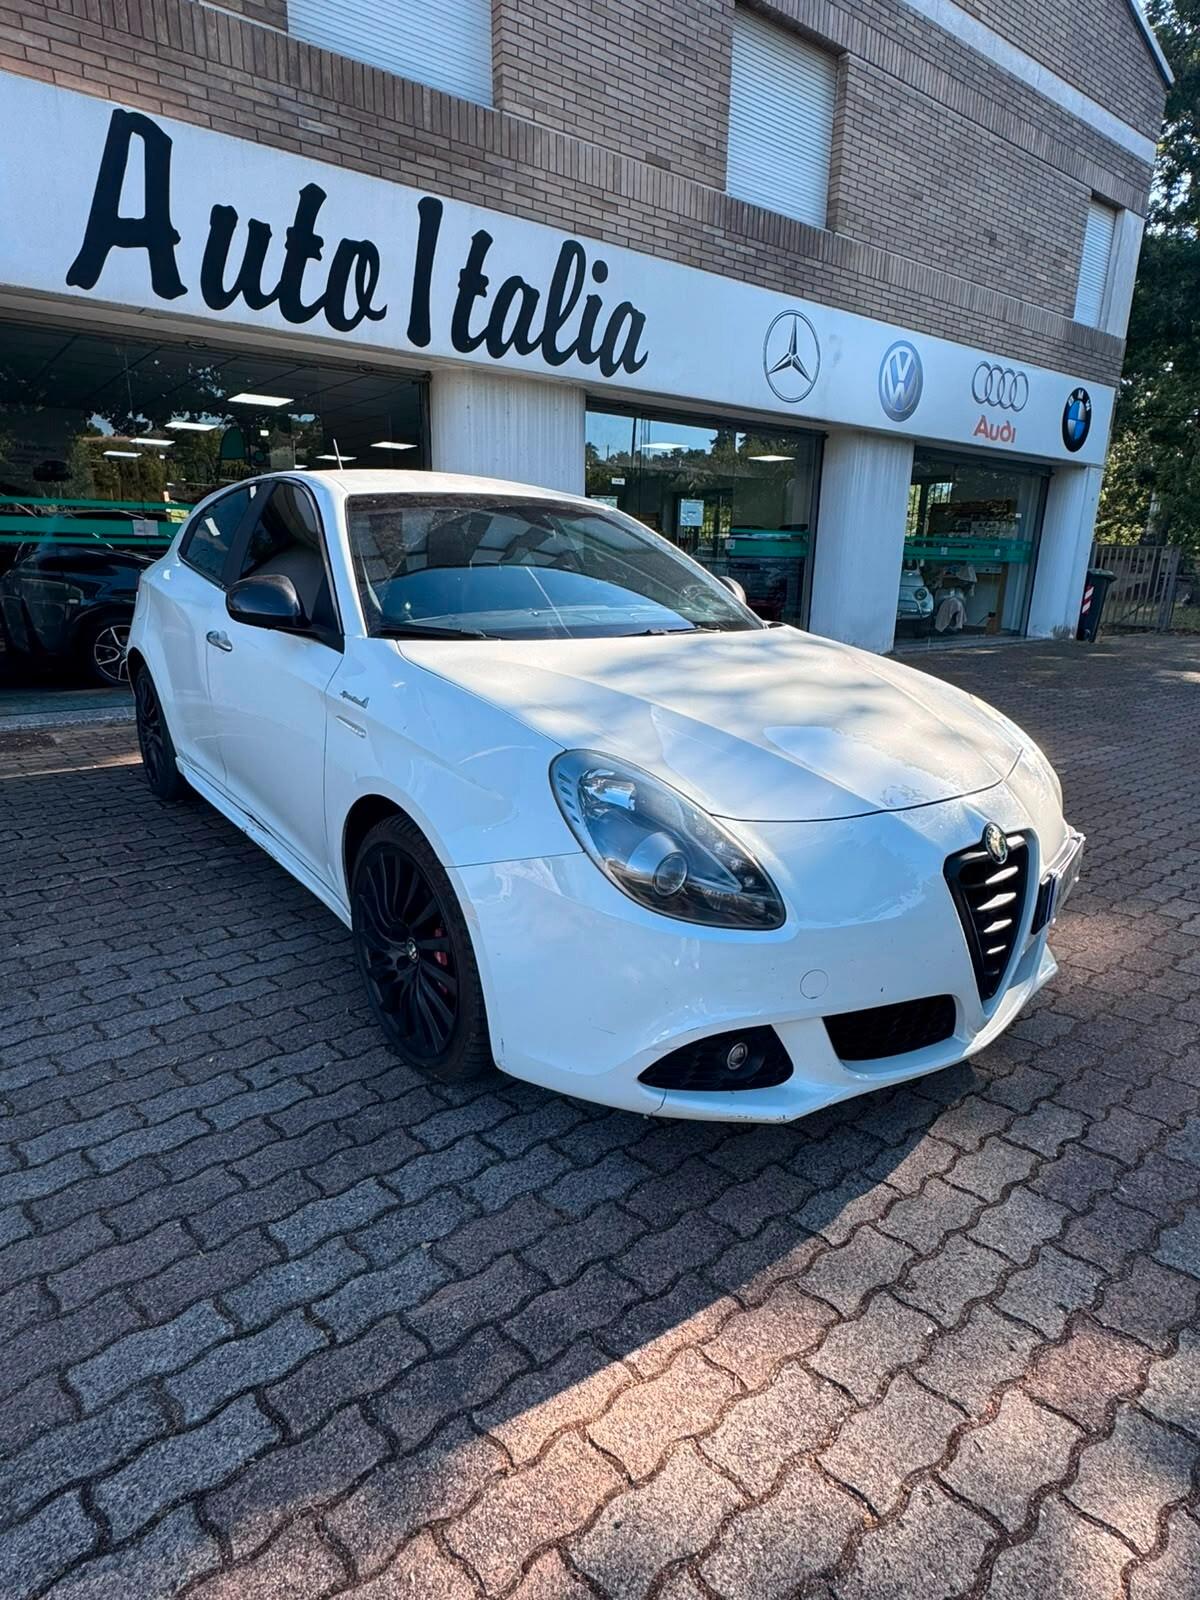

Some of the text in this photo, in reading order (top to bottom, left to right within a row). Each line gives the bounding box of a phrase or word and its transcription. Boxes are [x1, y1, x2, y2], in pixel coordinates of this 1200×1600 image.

[66, 107, 648, 378] Auto Italia
[973, 415, 1016, 443] Audi
